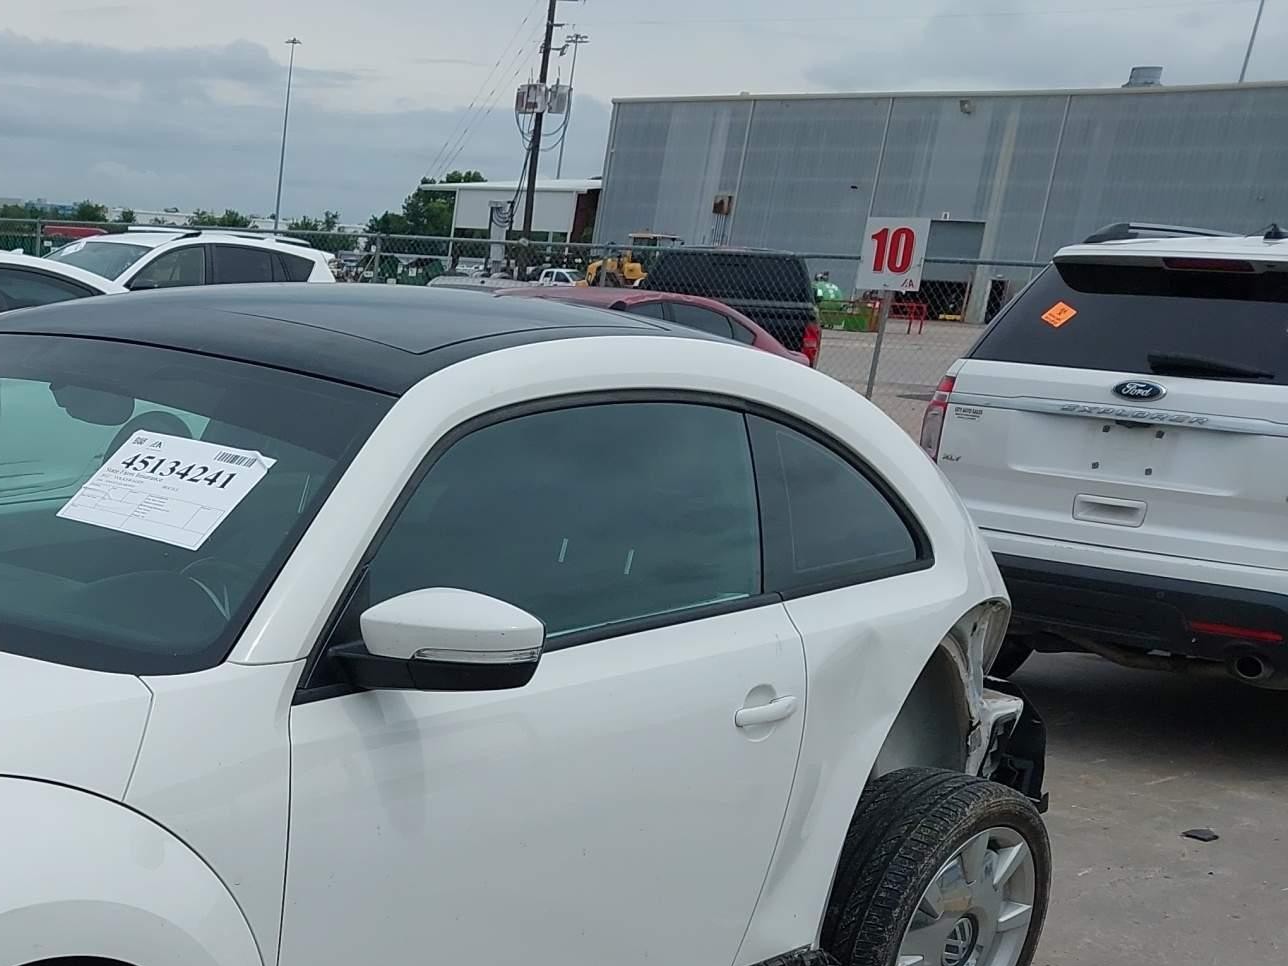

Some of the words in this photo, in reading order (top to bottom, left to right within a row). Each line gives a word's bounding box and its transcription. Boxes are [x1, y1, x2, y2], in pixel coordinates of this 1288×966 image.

[871, 226, 915, 273] 10
[1121, 382, 1152, 397] Ford
[1061, 403, 1209, 426] EXPLORER
[121, 453, 237, 489] 45134241
